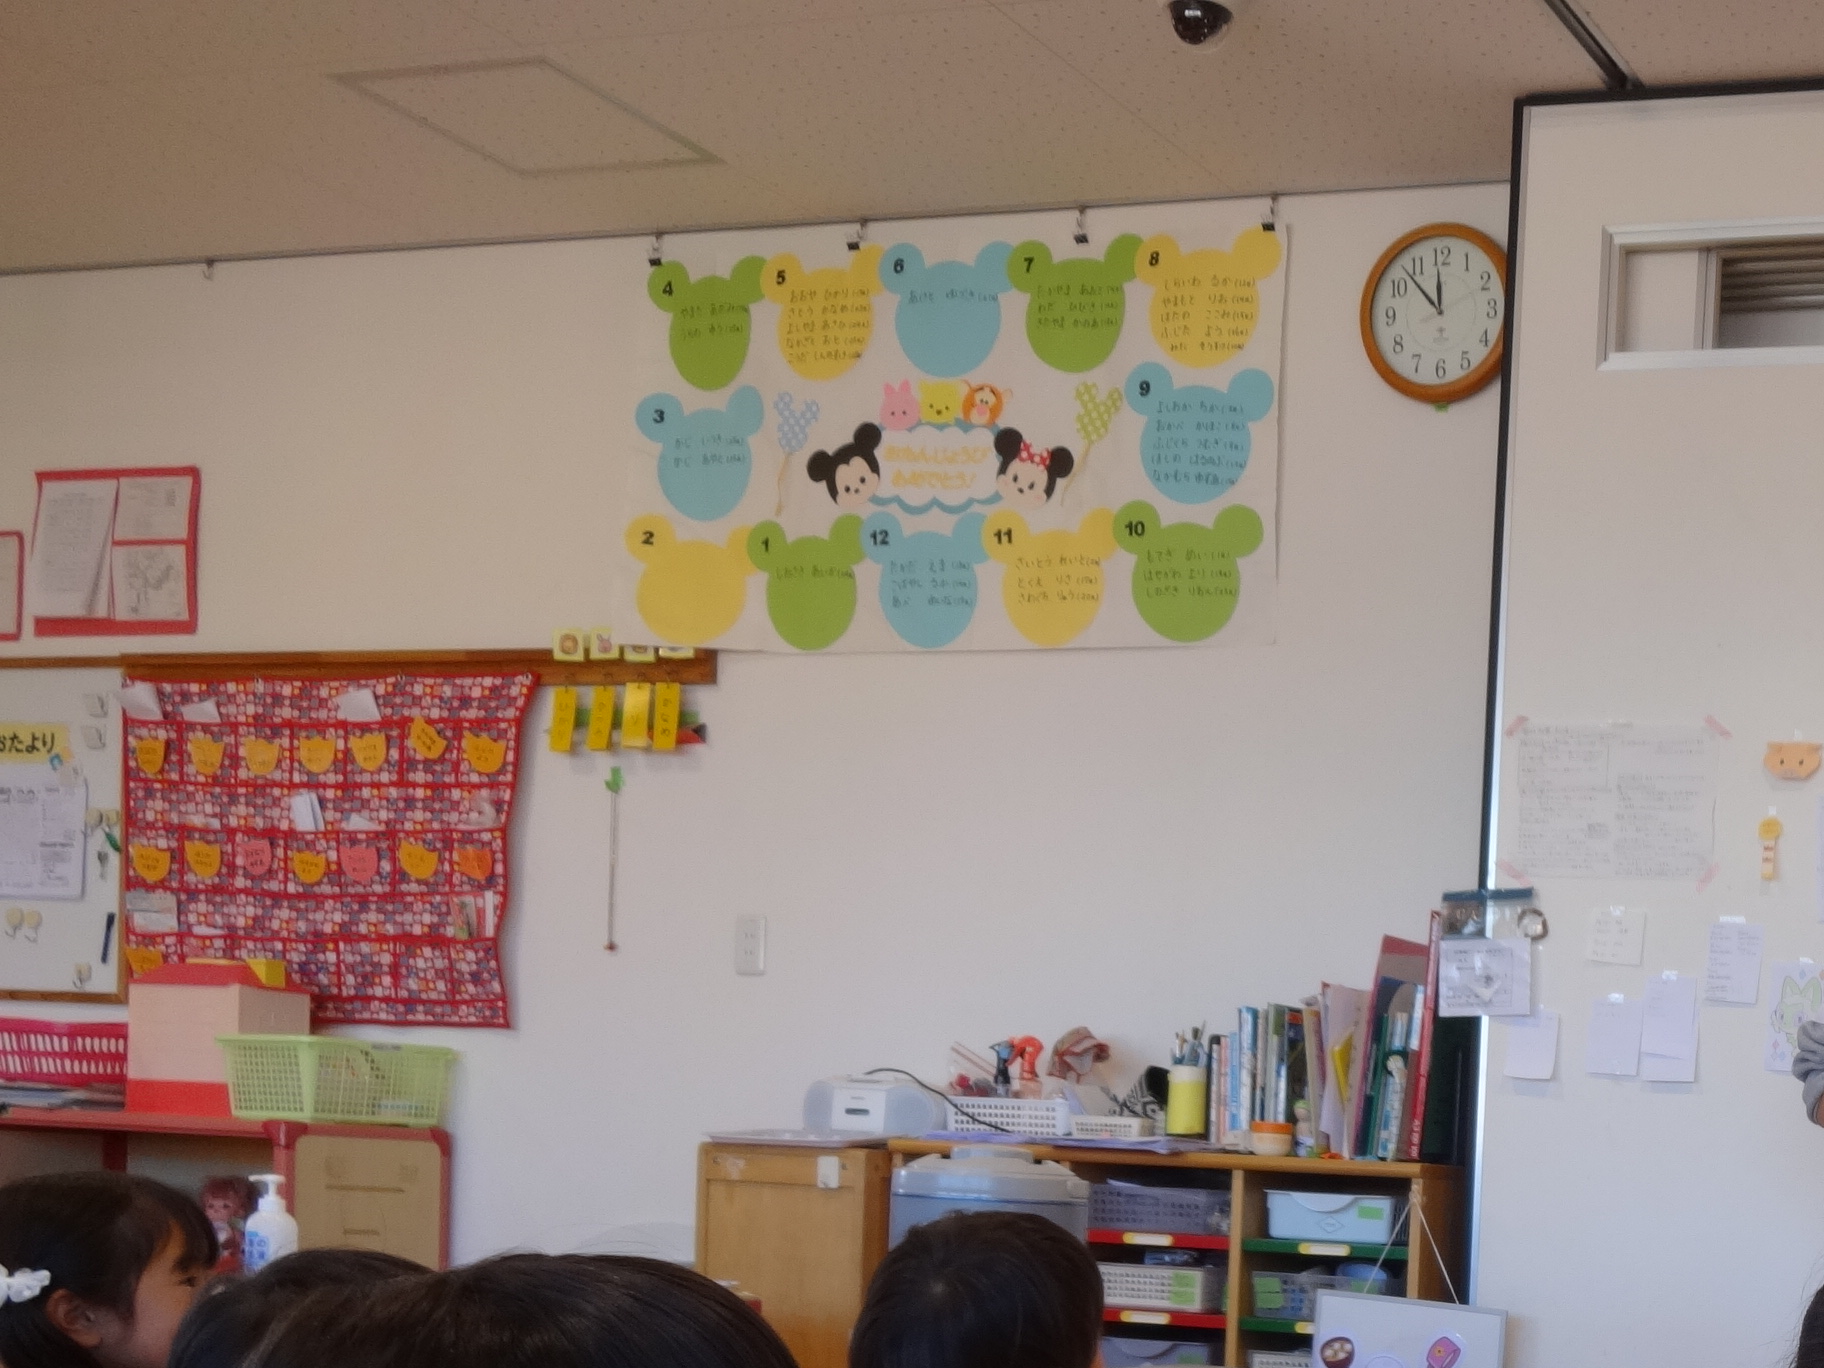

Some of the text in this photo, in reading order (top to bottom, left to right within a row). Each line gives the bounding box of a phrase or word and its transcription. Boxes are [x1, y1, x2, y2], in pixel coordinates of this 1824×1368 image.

[1023, 257, 1034, 272] 7
[1149, 251, 1160, 267] 8
[1432, 246, 1451, 267] 12
[1464, 252, 1470, 272] 1
[893, 258, 904, 274] 6
[1411, 257, 1424, 276] 11
[776, 270, 786, 285] 5
[1480, 271, 1491, 291] 2
[662, 281, 673, 296] 4
[1391, 277, 1408, 298] 10
[1385, 306, 1396, 326] 9
[1486, 298, 1497, 319] 3
[1393, 334, 1404, 353] 8
[1479, 328, 1489, 348] 4
[1411, 354, 1422, 373] 7
[1435, 359, 1446, 379] 6
[1460, 351, 1471, 370] 5
[1139, 380, 1151, 397] 9
[653, 409, 665, 423] 3
[993, 529, 1013, 545] 11
[1124, 520, 1145, 537] 10
[642, 531, 654, 546] 2
[761, 537, 769, 552] 1
[870, 530, 889, 546] 12
